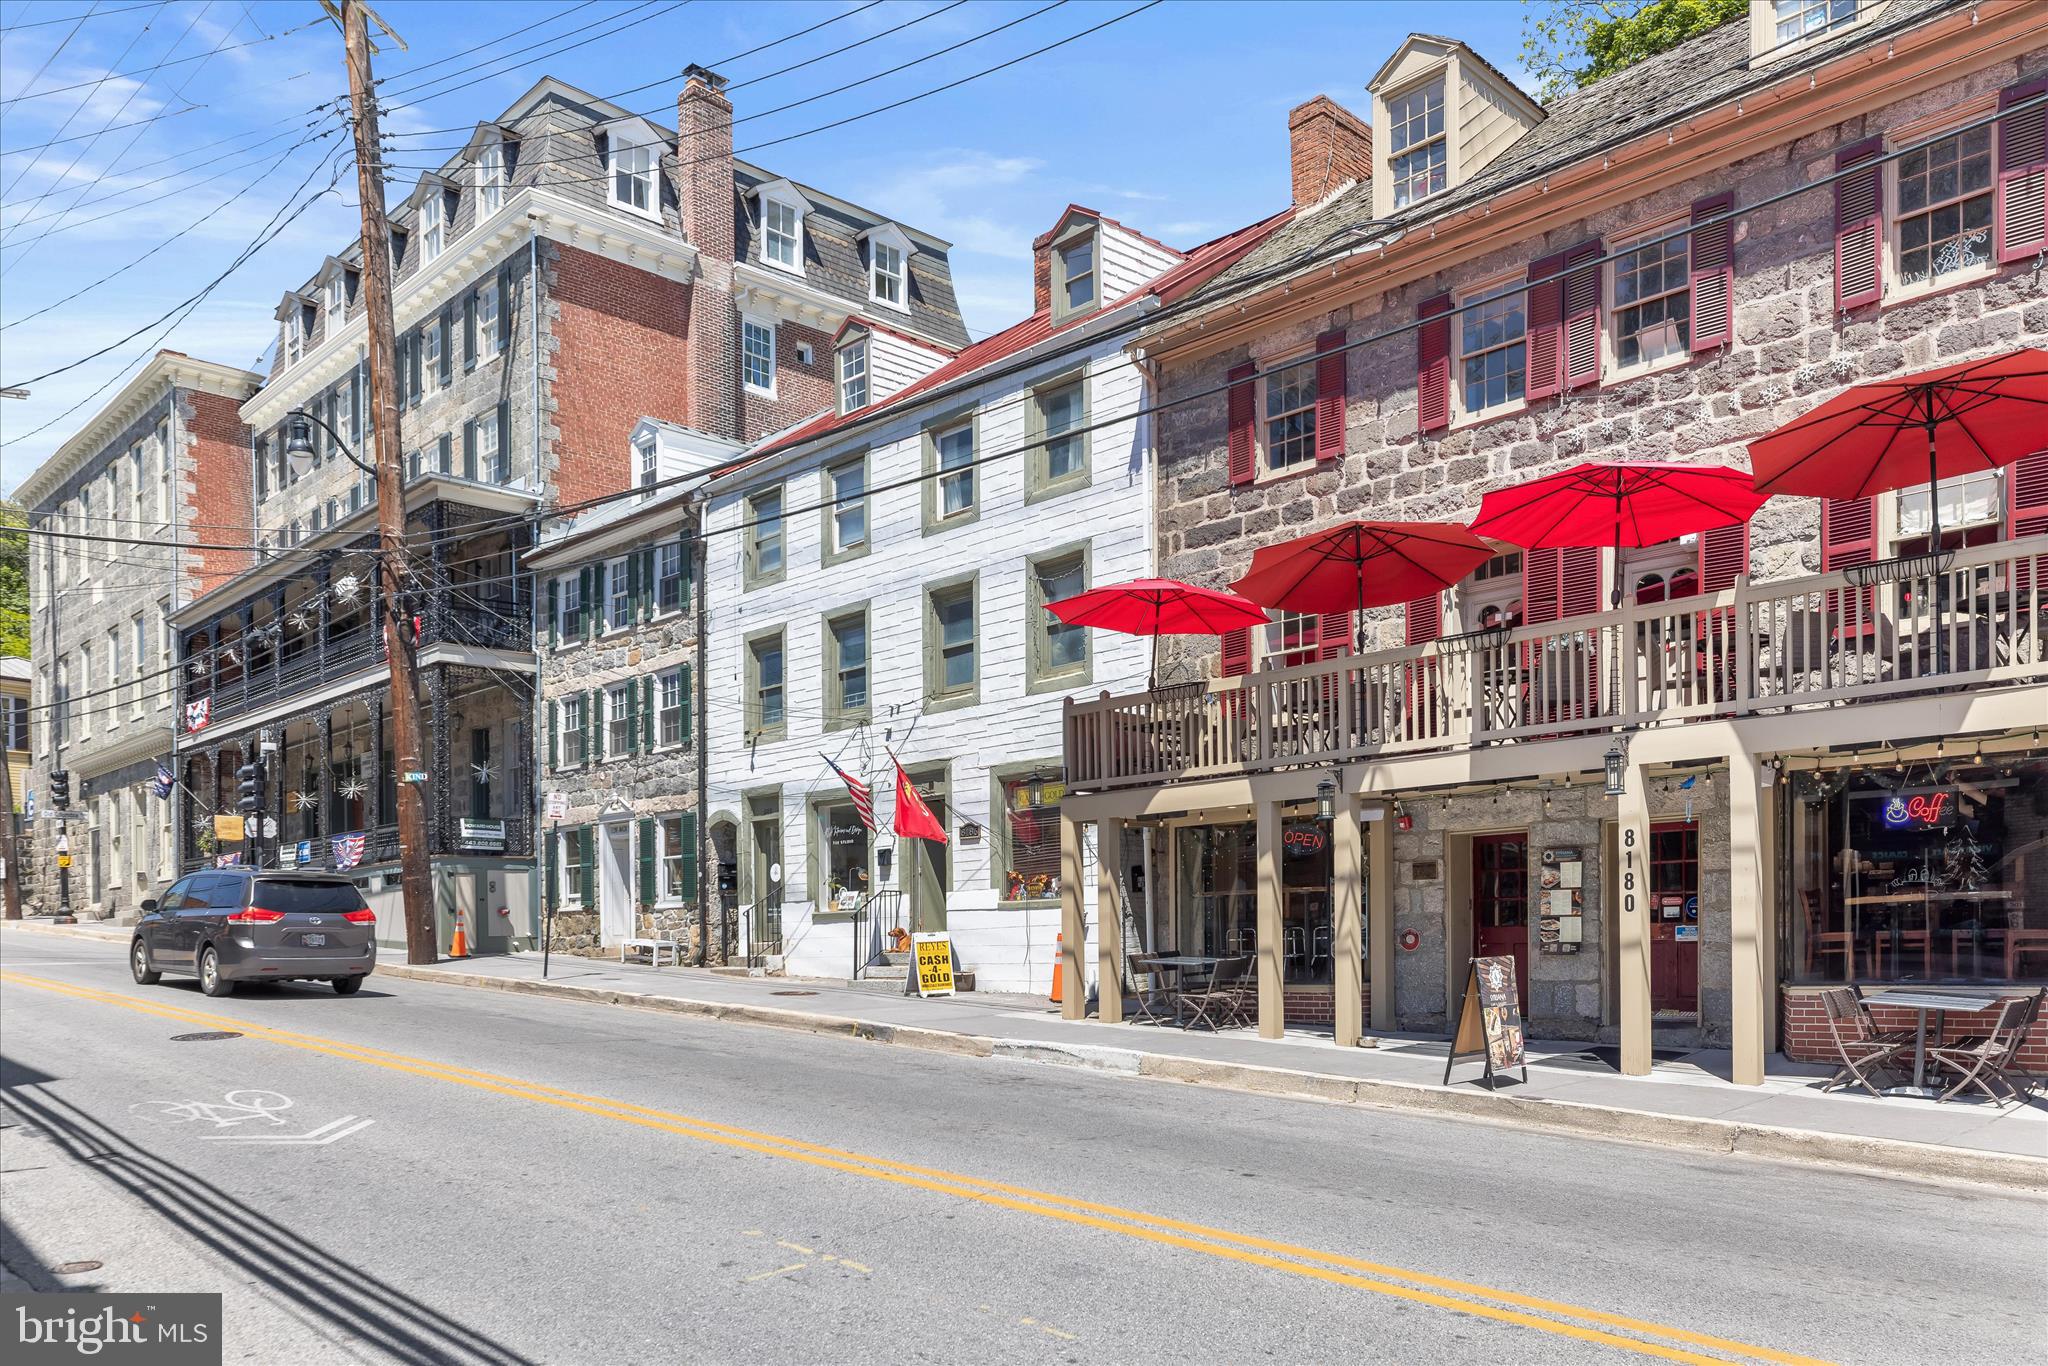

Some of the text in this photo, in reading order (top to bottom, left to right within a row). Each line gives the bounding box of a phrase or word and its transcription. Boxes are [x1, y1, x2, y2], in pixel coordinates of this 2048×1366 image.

[404, 772, 428, 782] KIND
[1909, 793, 1953, 822] Coffee
[1284, 831, 1325, 848] OPEN
[1624, 829, 1635, 912] 8180
[920, 942, 947, 951] REYES
[919, 954, 949, 965] CASH
[922, 973, 951, 983] GOLD
